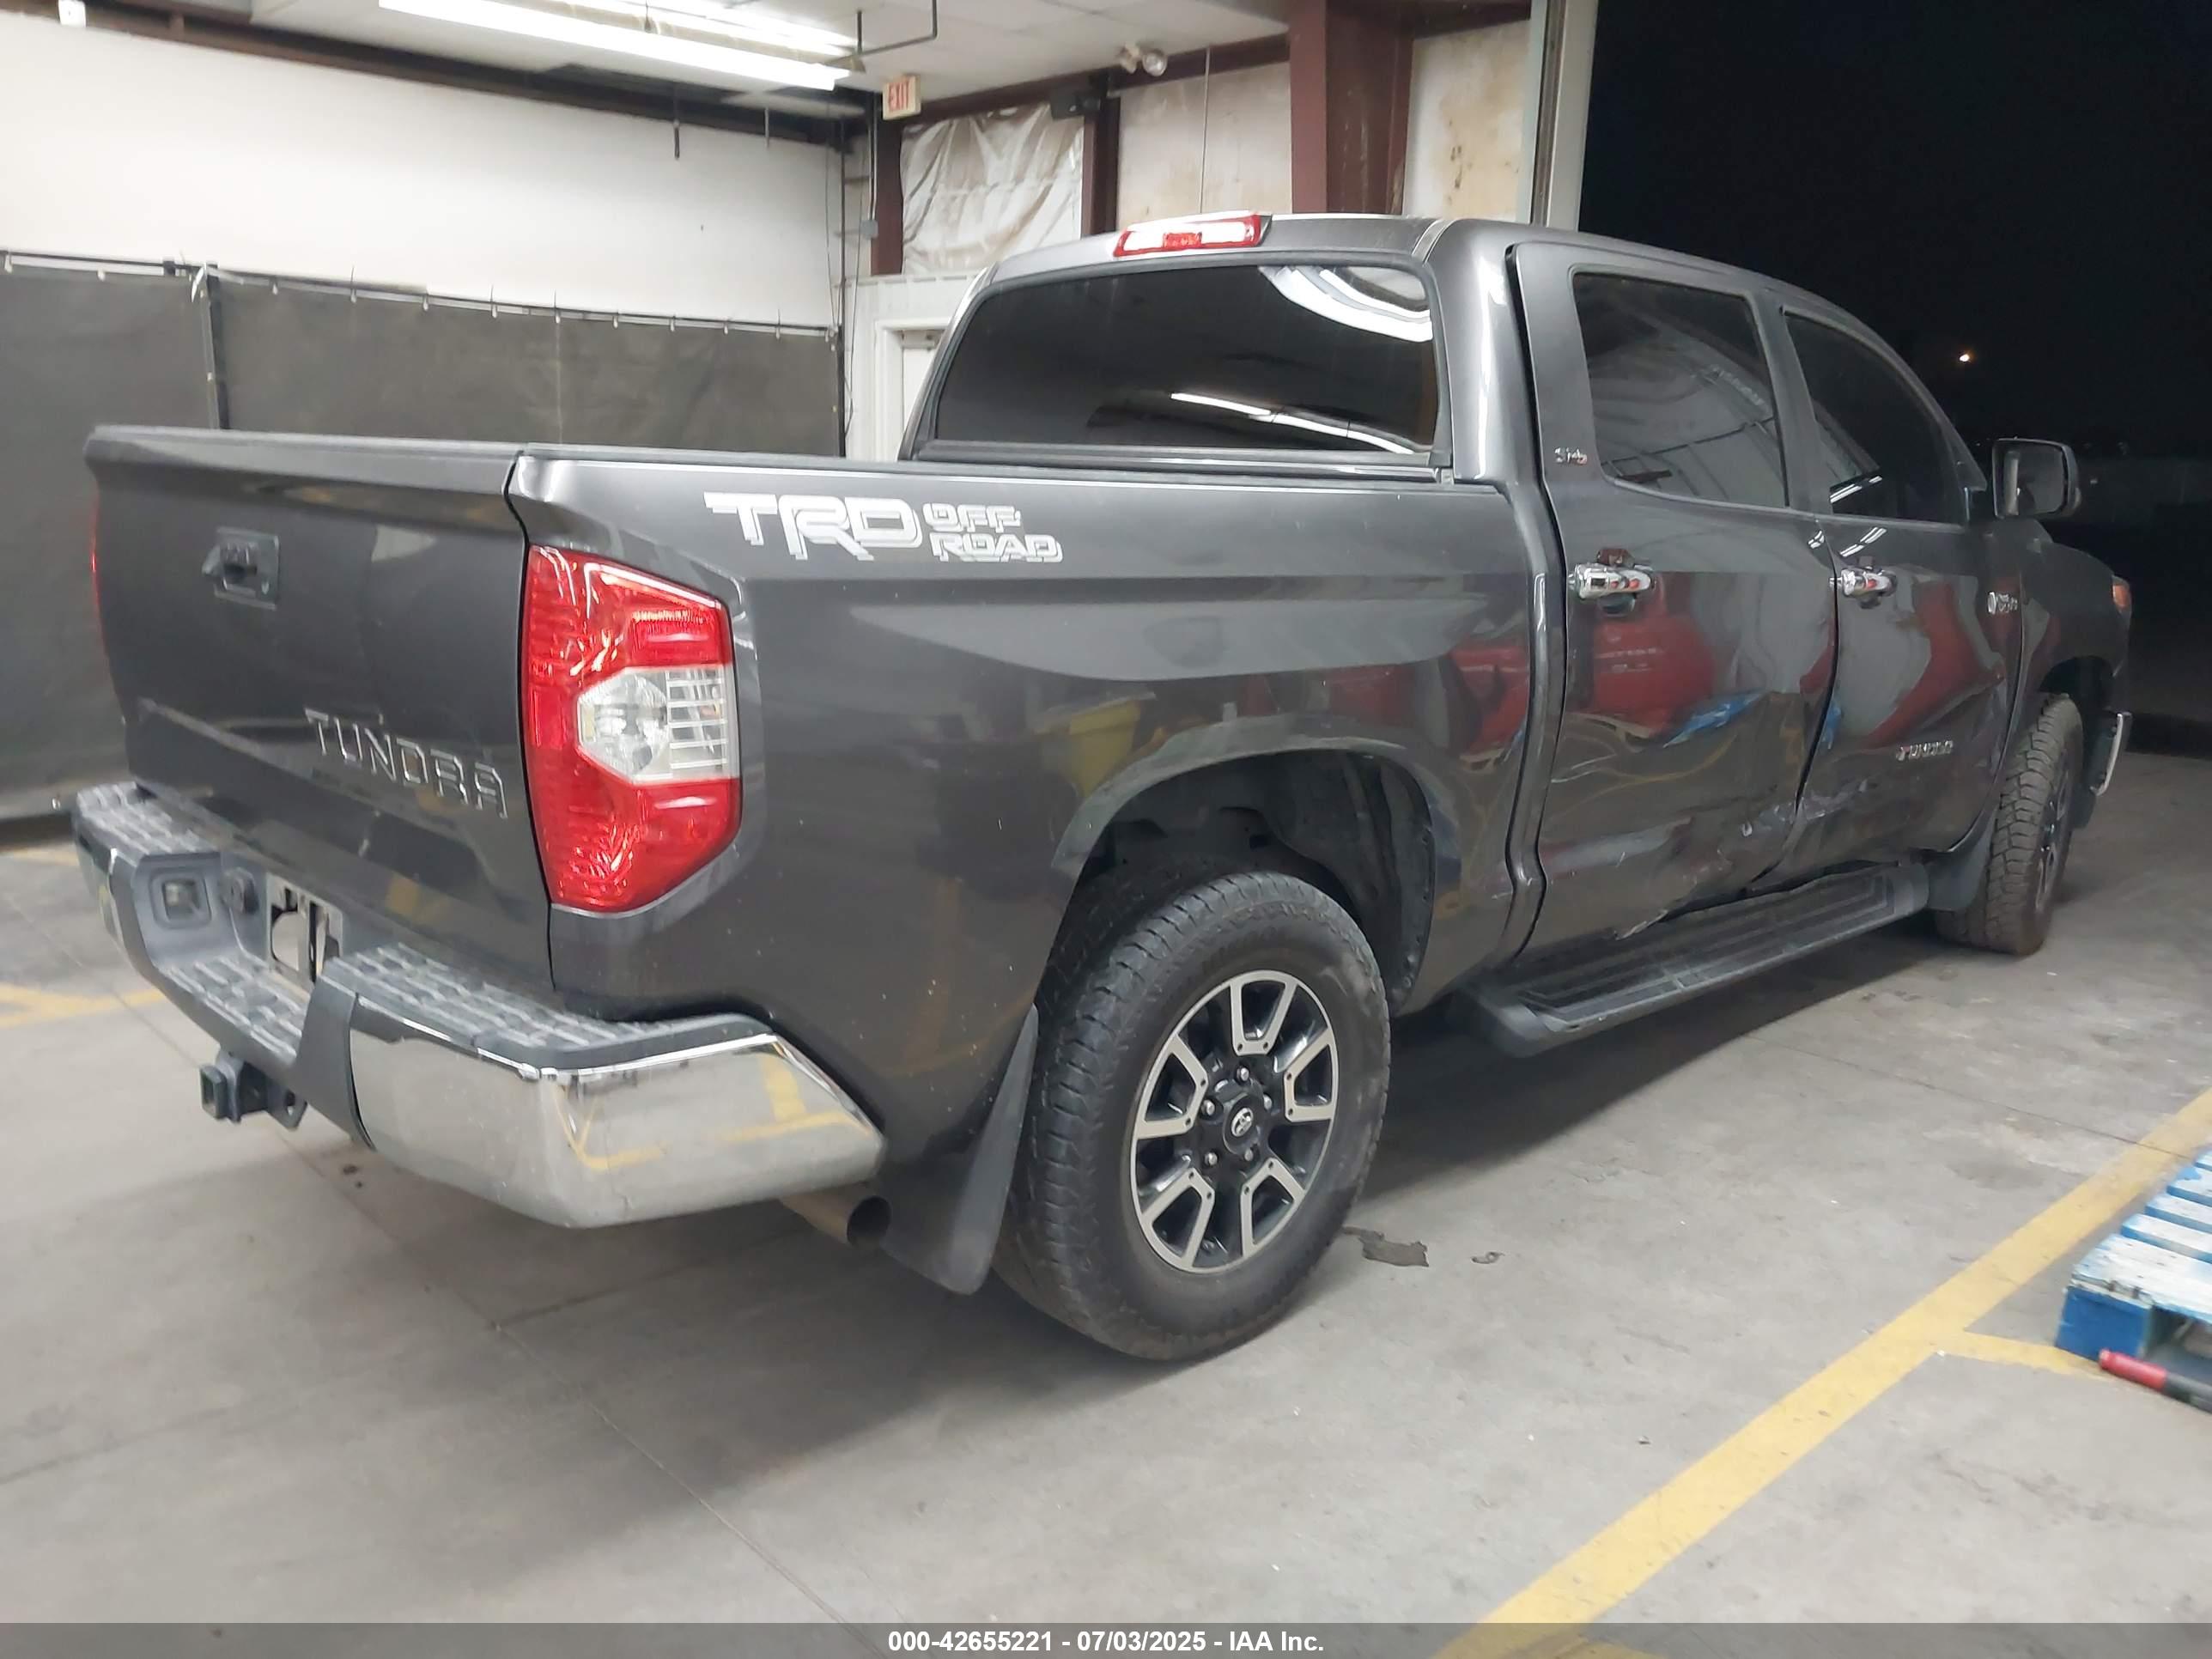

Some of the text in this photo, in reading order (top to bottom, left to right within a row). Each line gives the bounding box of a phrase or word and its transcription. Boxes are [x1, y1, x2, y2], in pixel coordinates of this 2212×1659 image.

[887, 79, 910, 112] EXIT
[703, 491, 923, 562] TRD
[922, 502, 1021, 533] OFF
[929, 532, 1064, 563] ROAD
[304, 707, 508, 819] TUNDRA
